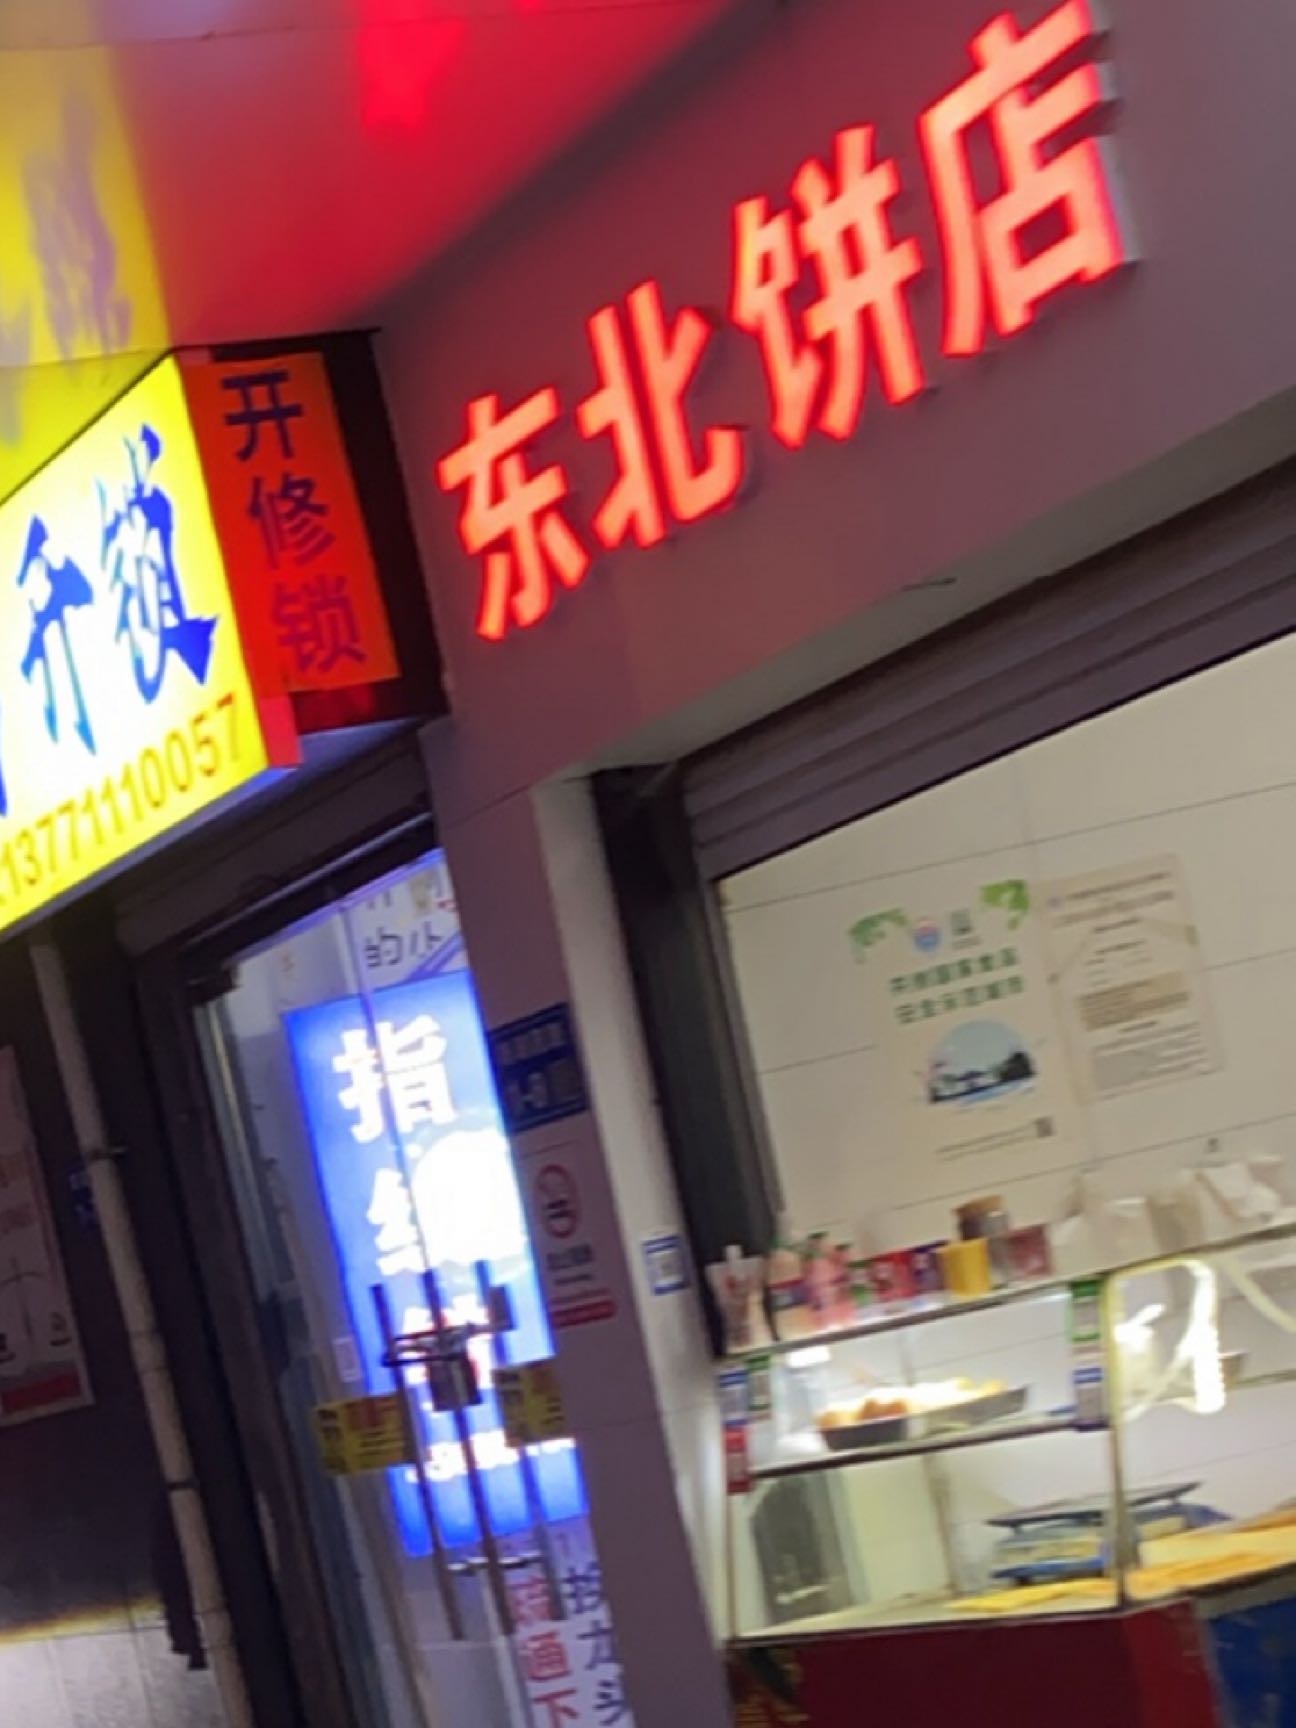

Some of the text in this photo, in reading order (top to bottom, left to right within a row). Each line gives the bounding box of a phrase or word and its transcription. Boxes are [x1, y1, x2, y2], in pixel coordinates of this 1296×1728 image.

[220, 369, 368, 673] 开修锁
[437, 0, 1126, 641] 东北饼店
